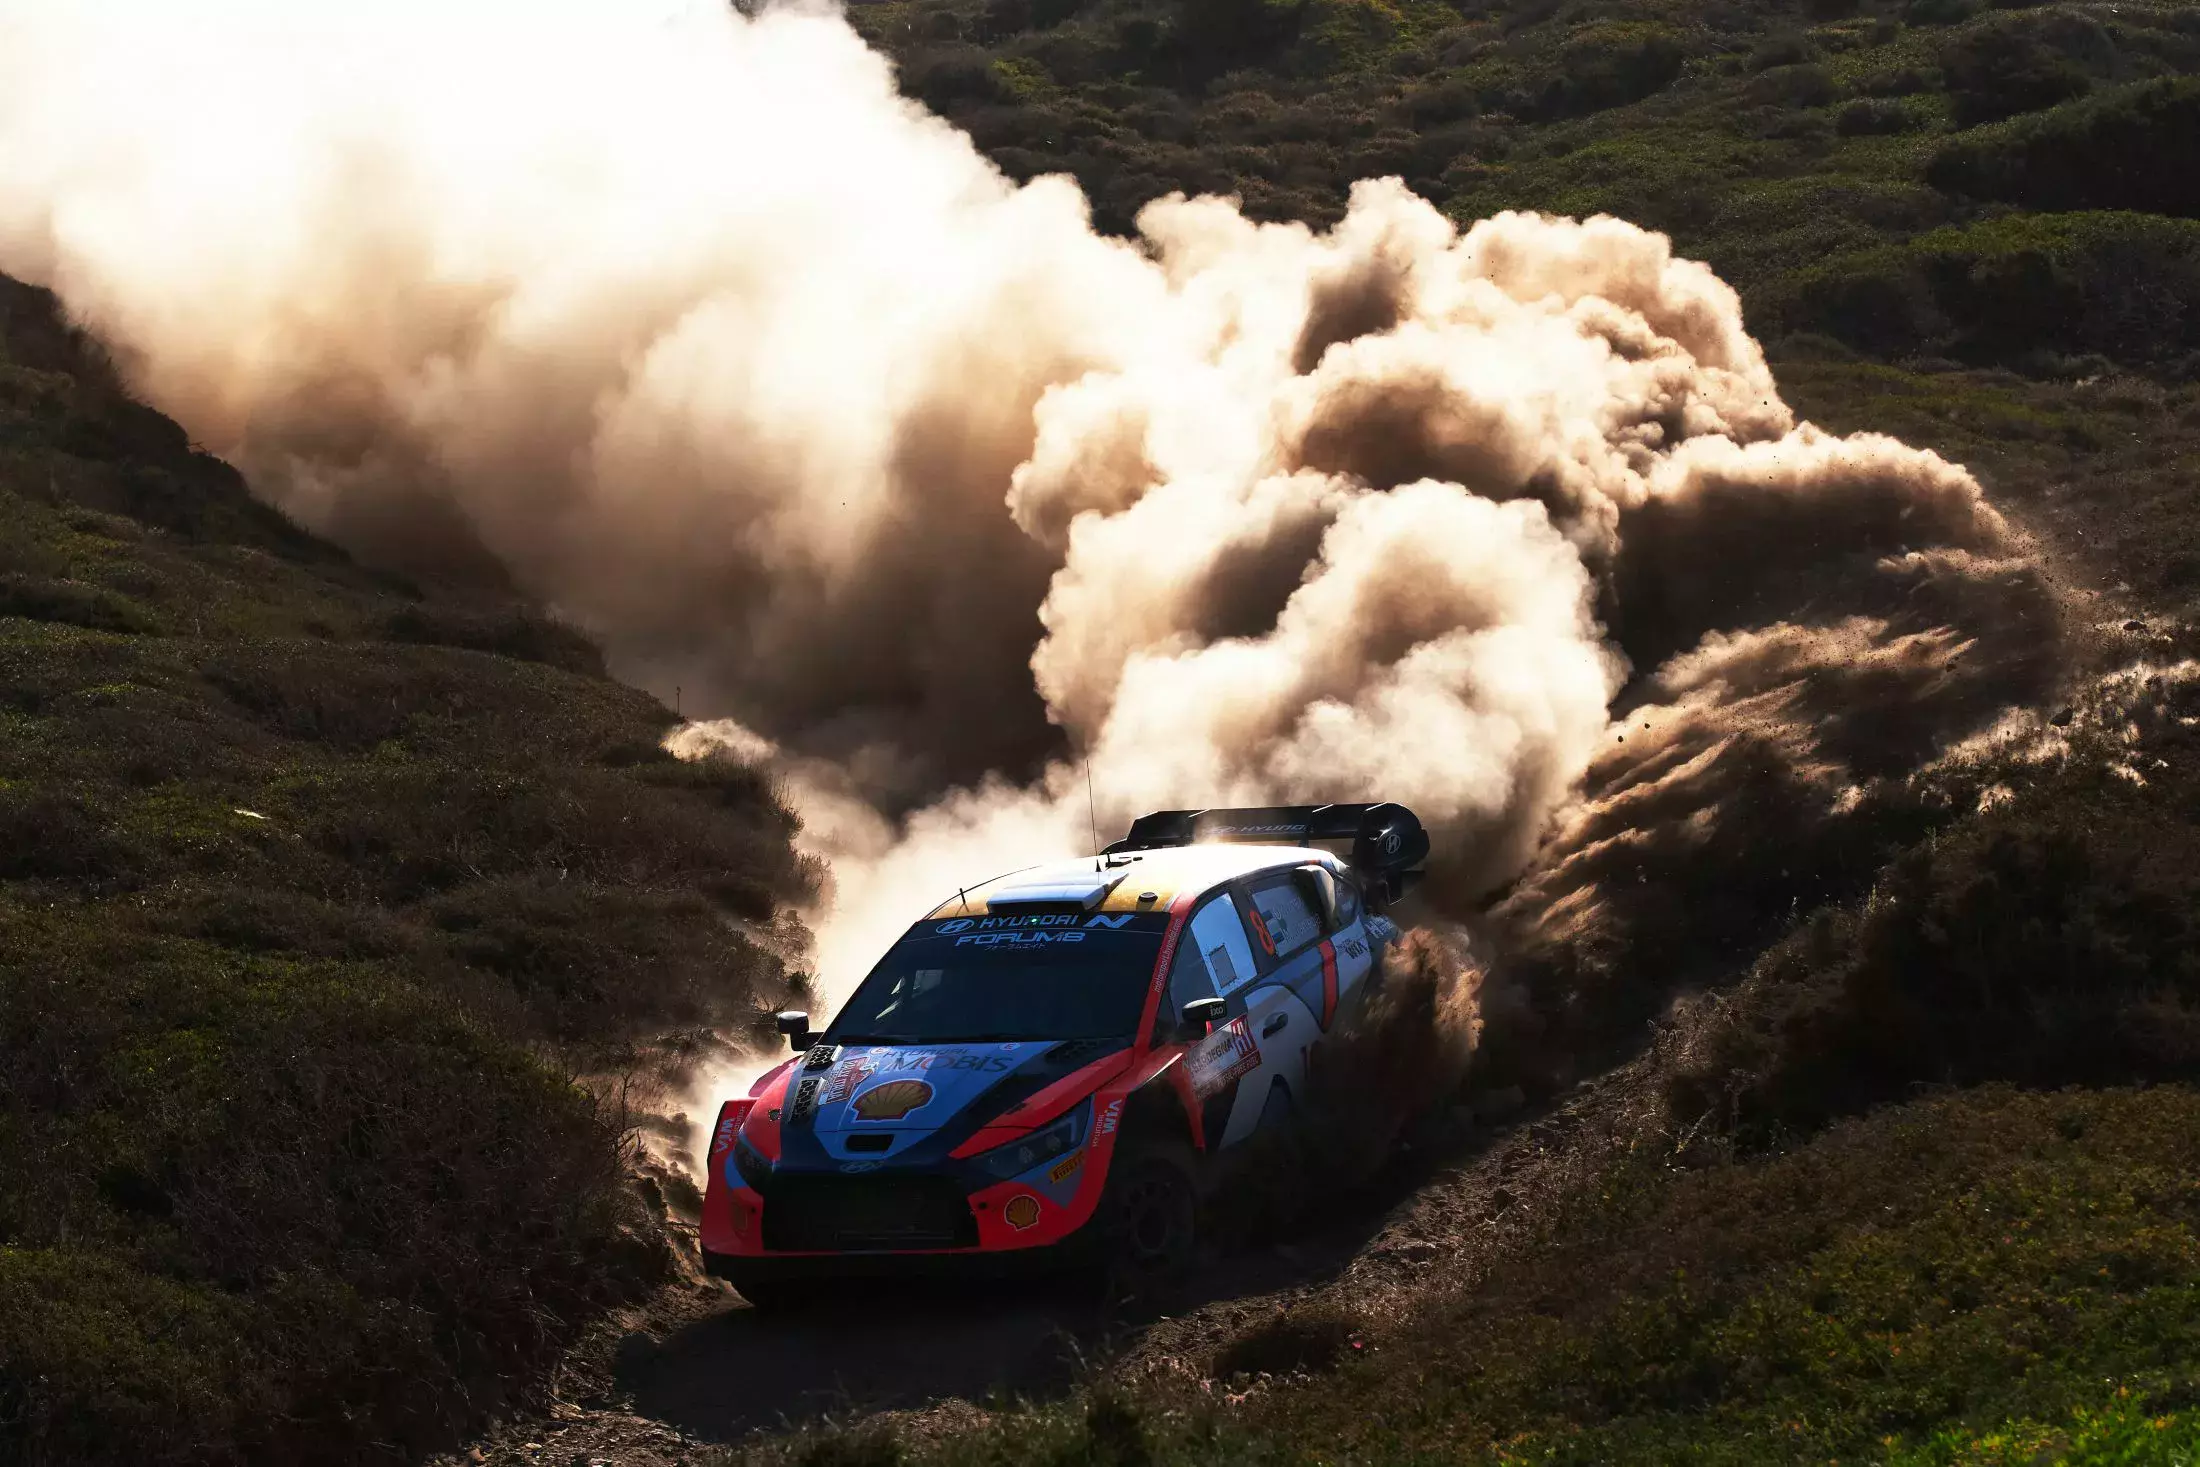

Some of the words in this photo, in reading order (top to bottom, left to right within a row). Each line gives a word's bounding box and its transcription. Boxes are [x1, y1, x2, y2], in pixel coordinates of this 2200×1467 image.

[1083, 914, 1136, 929] N
[1249, 910, 1276, 956] 8
[954, 931, 1086, 946] FORUM8
[1153, 918, 1182, 993] motorsport.hyundai.com
[883, 1048, 970, 1058] HYUNDAI
[883, 1055, 1014, 1072] MOBIS
[1102, 1098, 1123, 1135] WIA
[715, 1117, 736, 1153] WIA
